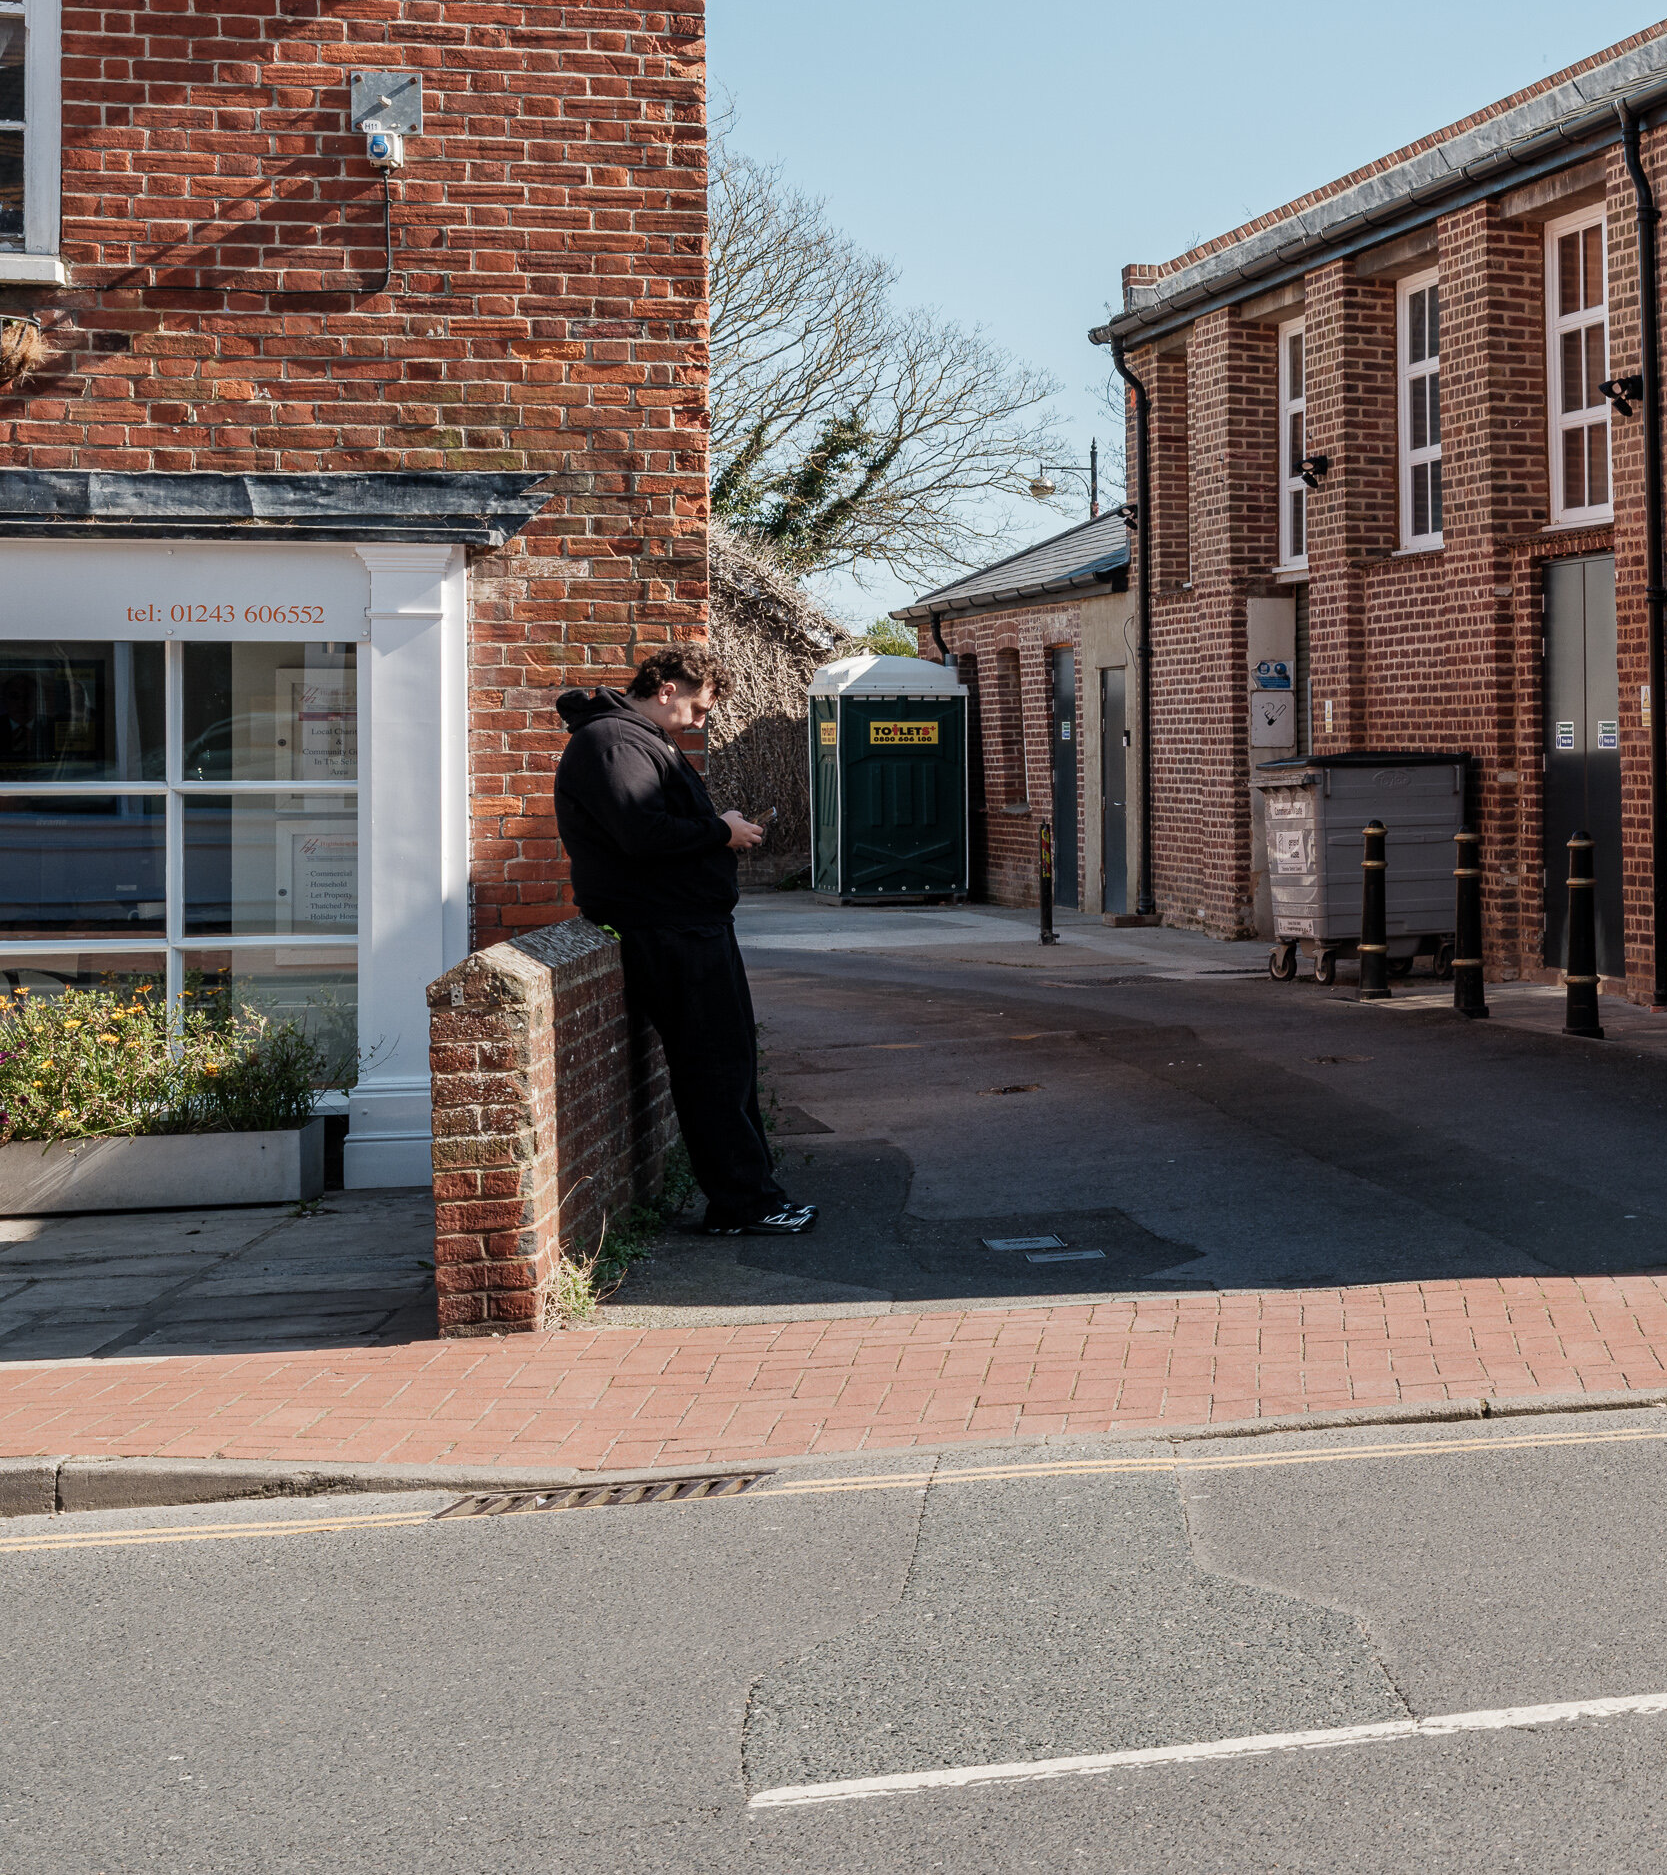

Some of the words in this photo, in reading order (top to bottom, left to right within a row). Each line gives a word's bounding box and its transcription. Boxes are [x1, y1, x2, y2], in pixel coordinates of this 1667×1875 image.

[127, 604, 161, 622] tel:
[170, 604, 235, 623] 01243
[244, 605, 324, 624] 606552
[302, 748, 346, 756] Community
[324, 892, 352, 900] Property
